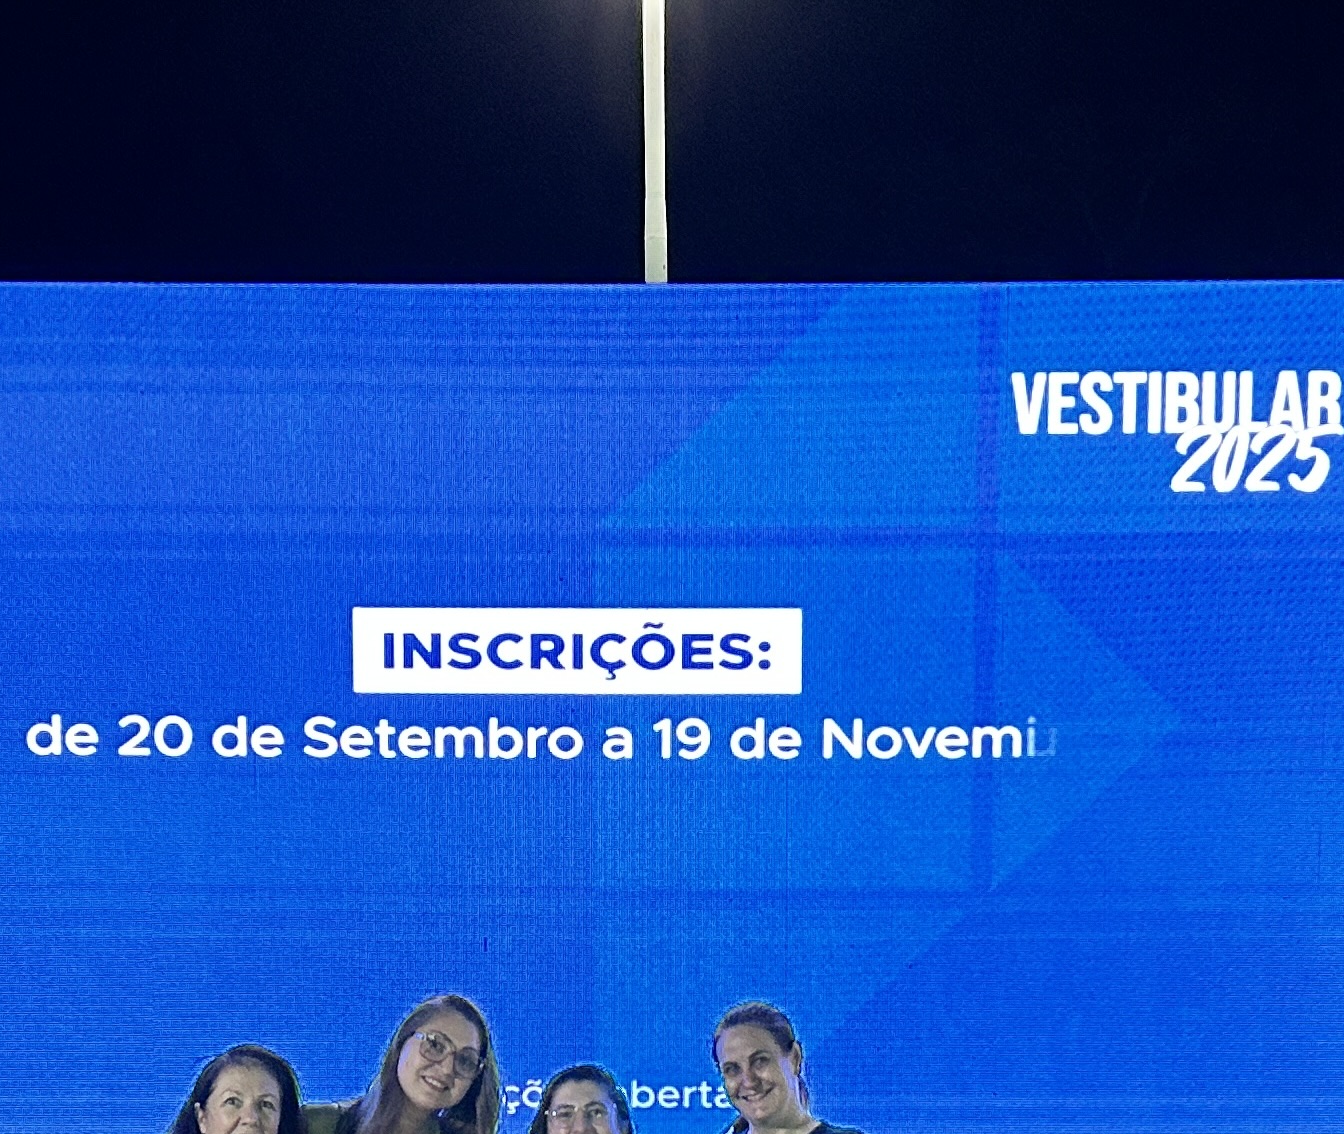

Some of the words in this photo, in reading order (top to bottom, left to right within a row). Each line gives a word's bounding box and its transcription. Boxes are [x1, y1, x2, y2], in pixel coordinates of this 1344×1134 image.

[1010, 369, 1343, 435] VESTIBULAR
[1170, 424, 1344, 493] 2025
[383, 622, 772, 680] INSCRIÇÕES:
[26, 713, 99, 756] de
[118, 714, 193, 757] 20
[212, 715, 284, 758] de
[303, 715, 584, 759] Setembro
[602, 726, 633, 760] a
[652, 717, 711, 760] 19
[730, 717, 802, 760] de
[618, 1079, 732, 1110] berta
